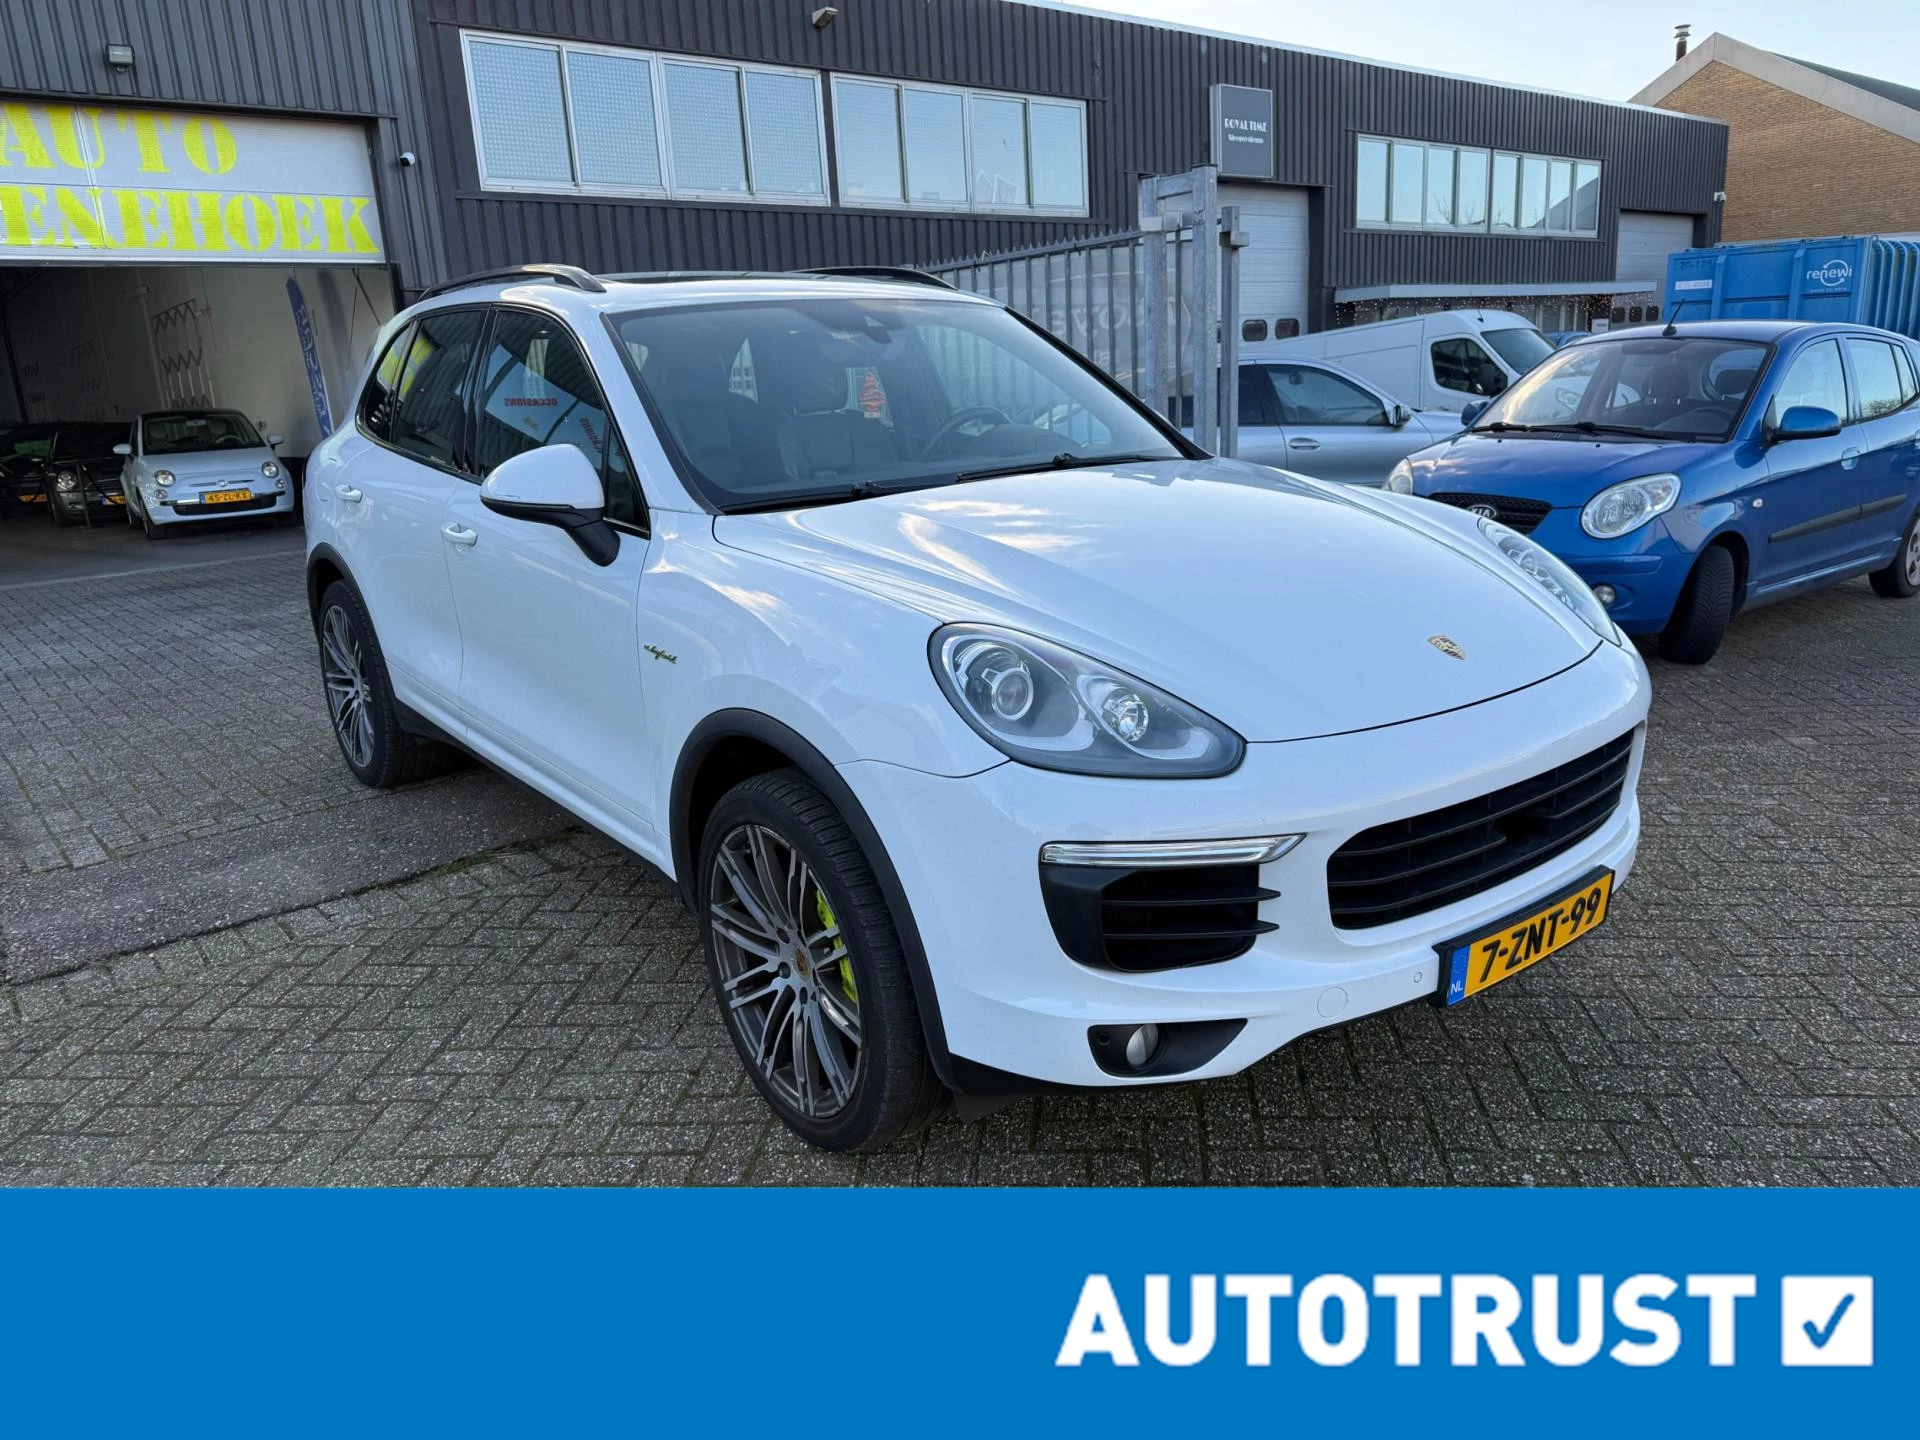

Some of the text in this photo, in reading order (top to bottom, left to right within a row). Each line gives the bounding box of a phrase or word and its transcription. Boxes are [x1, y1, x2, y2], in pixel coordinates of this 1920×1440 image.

[1224, 118, 1268, 133] ROYAL TIME
[0, 102, 238, 176] AUTO
[1806, 263, 1853, 281] renewi
[1479, 887, 1602, 983] 7-ZNT-99
[1450, 980, 1464, 995] NL
